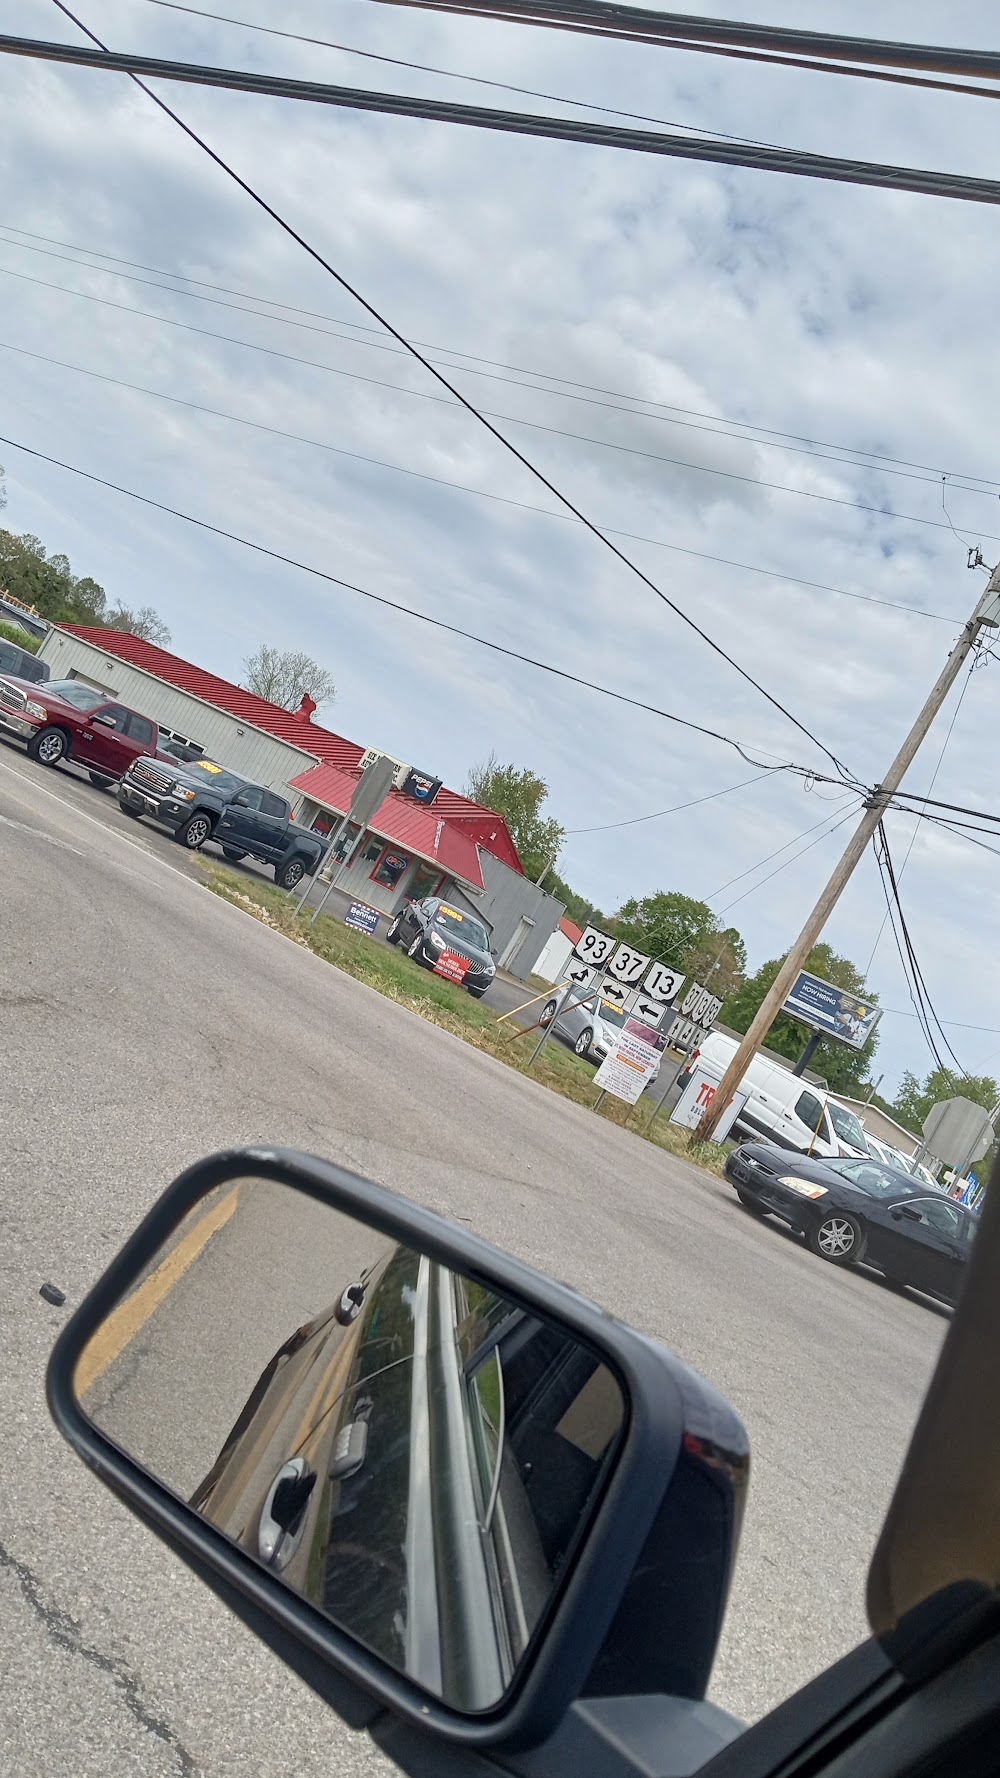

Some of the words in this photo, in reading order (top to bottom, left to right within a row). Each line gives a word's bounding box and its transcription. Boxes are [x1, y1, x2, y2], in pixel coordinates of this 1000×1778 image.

[367, 750, 377, 761] SIX
[410, 772, 433, 788] PEPSI
[387, 856, 405, 869] OPEN
[349, 906, 377, 923] Bennett
[582, 934, 608, 959] 93
[615, 952, 643, 975] 37
[651, 971, 675, 995] 13
[685, 988, 700, 1008] 37
[801, 984, 817, 995] NOW
[816, 991, 836, 1005] HIRING
[695, 997, 708, 1016] 13
[706, 1003, 718, 1023] 93
